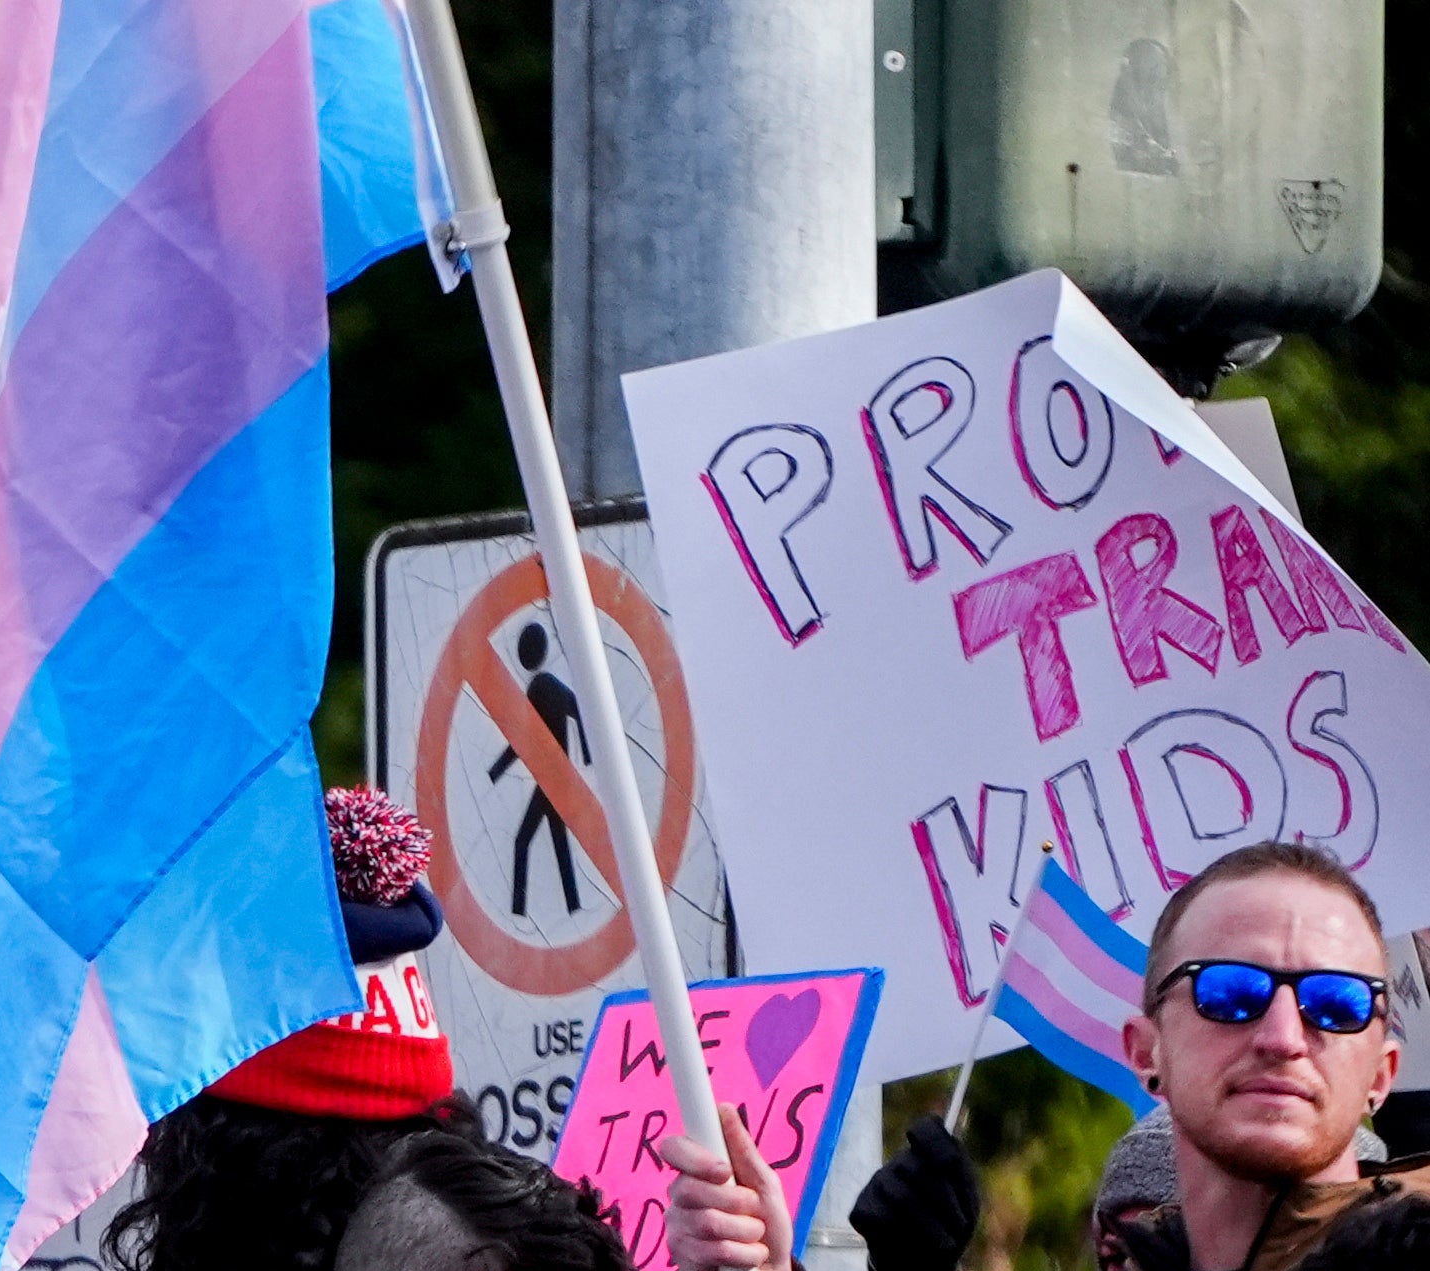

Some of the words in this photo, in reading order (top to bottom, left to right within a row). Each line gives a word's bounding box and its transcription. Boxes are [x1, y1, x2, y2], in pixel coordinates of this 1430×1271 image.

[951, 505, 1407, 743] TRAN
[910, 671, 1378, 1008] KIDS
[533, 1020, 585, 1058] USE
[620, 1010, 731, 1083] WE
[598, 1083, 824, 1175] TRNS
